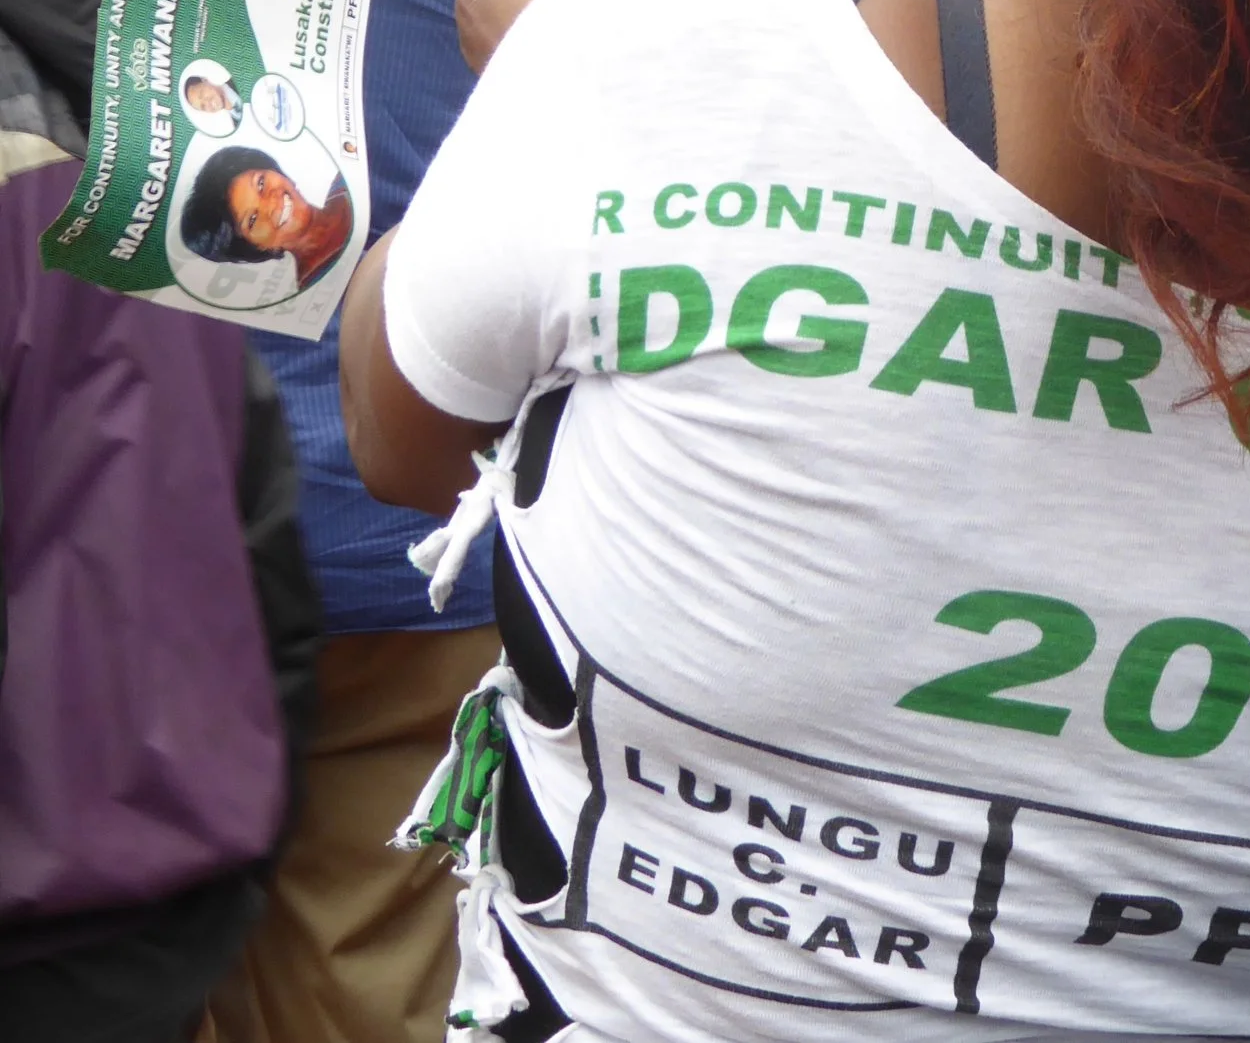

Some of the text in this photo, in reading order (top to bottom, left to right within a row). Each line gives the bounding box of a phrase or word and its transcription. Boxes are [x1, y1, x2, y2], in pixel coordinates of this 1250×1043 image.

[57, 216, 91, 245] FOR
[84, 93, 120, 215] CONTINUITY,
[106, 29, 121, 89] UNITY
[109, 98, 173, 261] MARGARET
[653, 181, 1136, 288] CONTINUIT
[624, 745, 955, 877] LUNGU
[732, 842, 817, 896] C.
[617, 842, 931, 970] EDGAR
